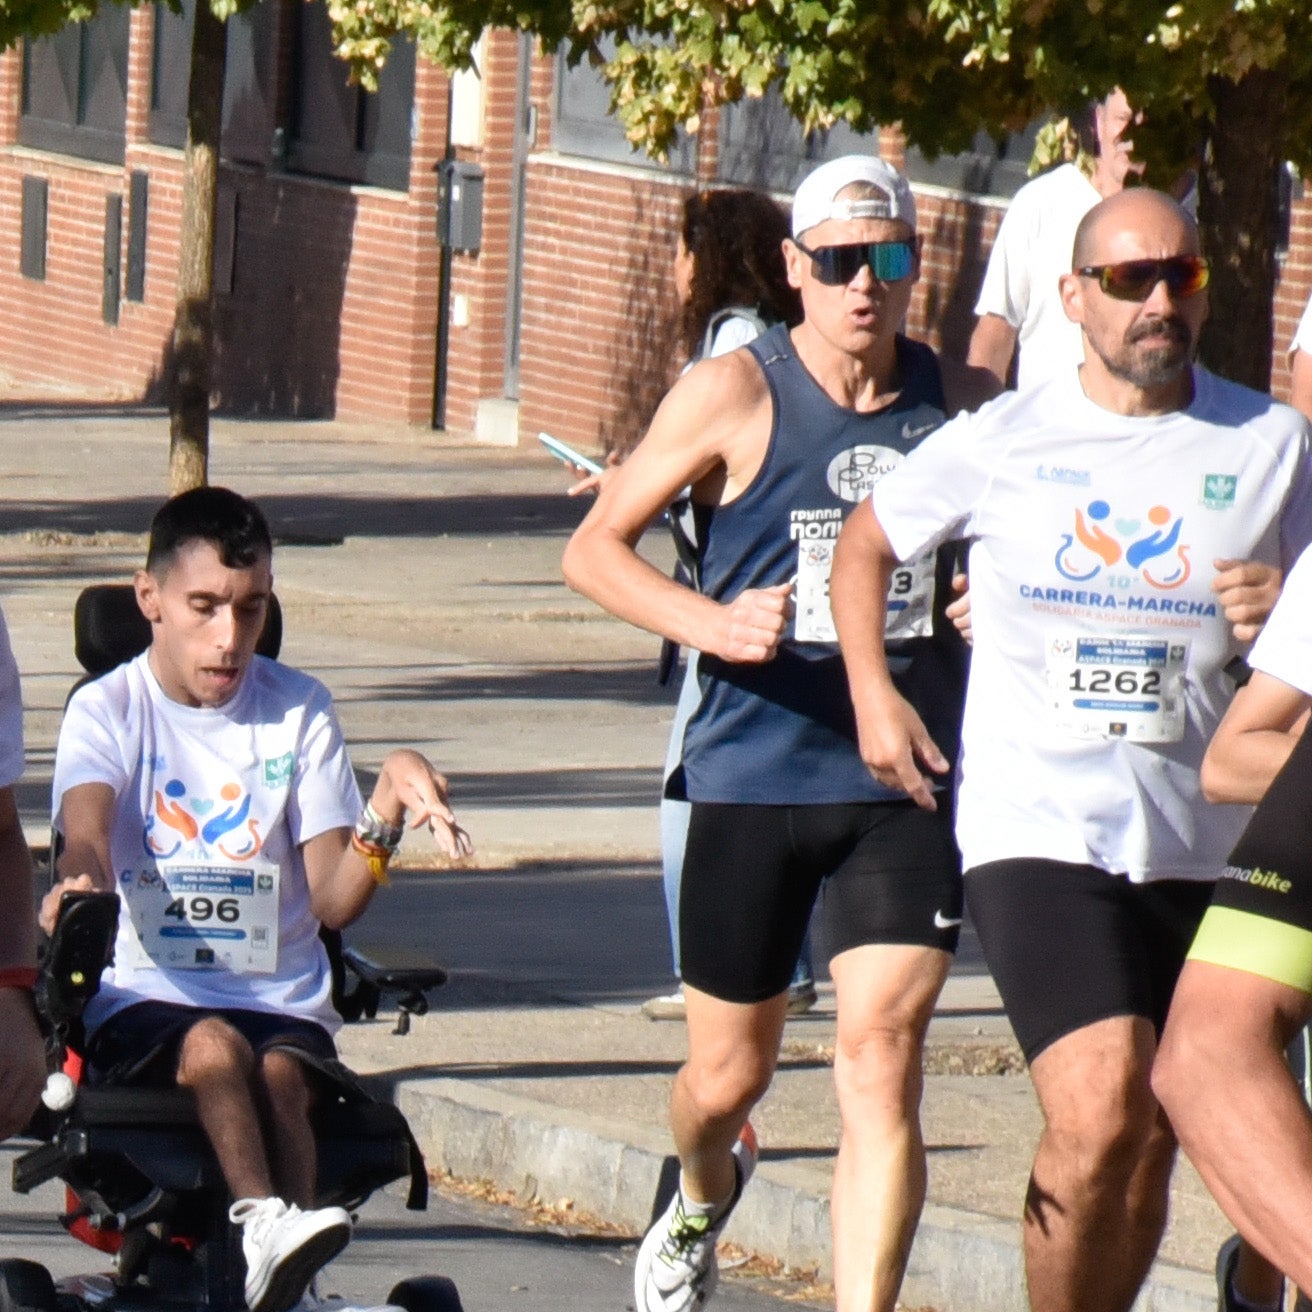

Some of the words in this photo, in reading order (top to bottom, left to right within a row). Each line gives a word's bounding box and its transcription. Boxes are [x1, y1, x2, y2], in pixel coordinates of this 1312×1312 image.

[1019, 583, 1217, 618] CARRERA-MARCHA
[1068, 668, 1161, 695] 1262
[164, 896, 240, 923] 496
